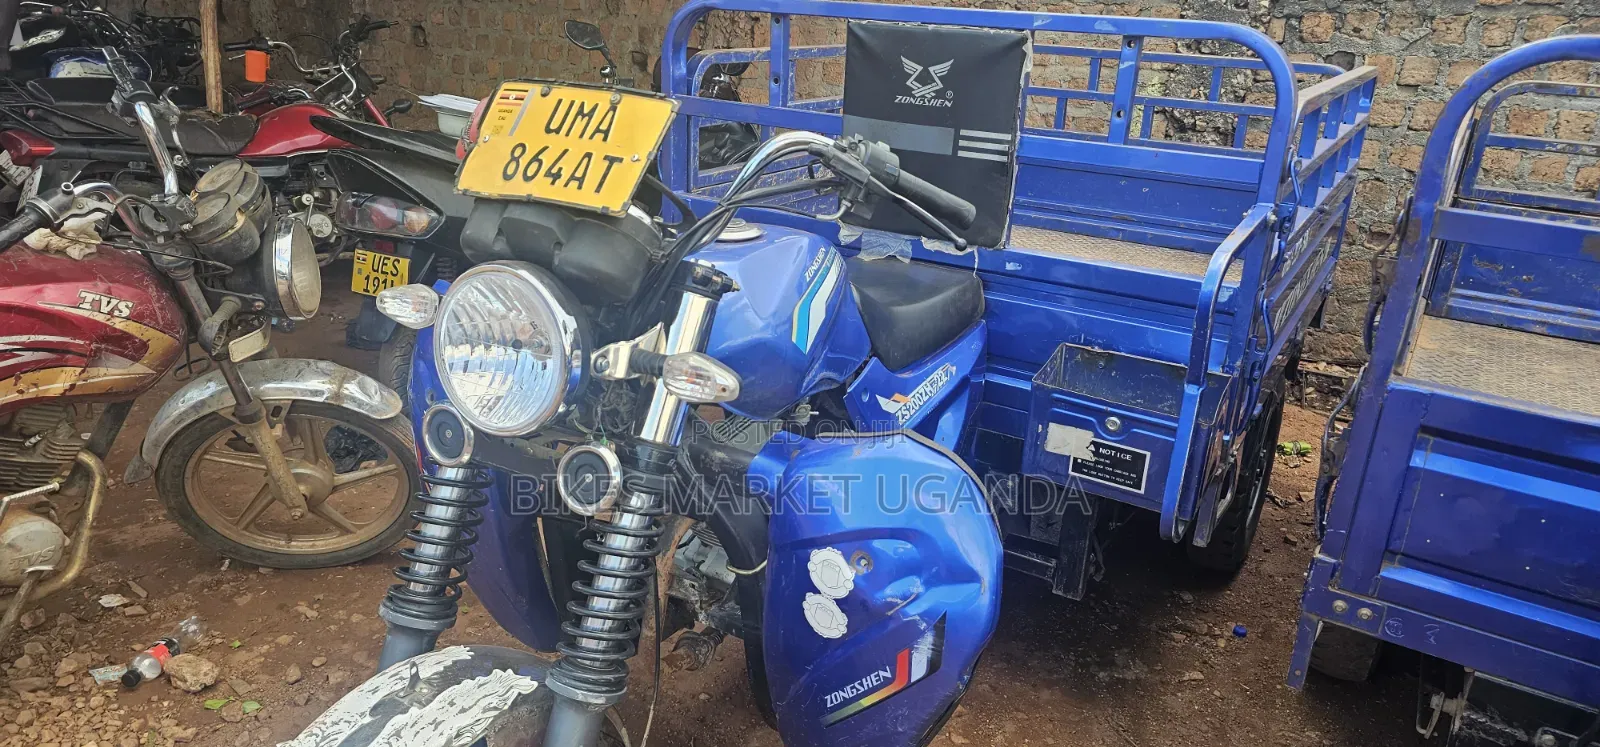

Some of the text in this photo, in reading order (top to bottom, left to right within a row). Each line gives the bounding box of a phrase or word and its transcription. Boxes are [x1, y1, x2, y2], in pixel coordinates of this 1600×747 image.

[894, 95, 953, 108] ZONGSHEN
[544, 98, 618, 142] UMA
[502, 142, 624, 194] 864AT
[371, 254, 400, 277] UES
[78, 290, 134, 317] TVS
[1099, 447, 1133, 461] NOTICE
[824, 665, 892, 708] ZONGSHEN
